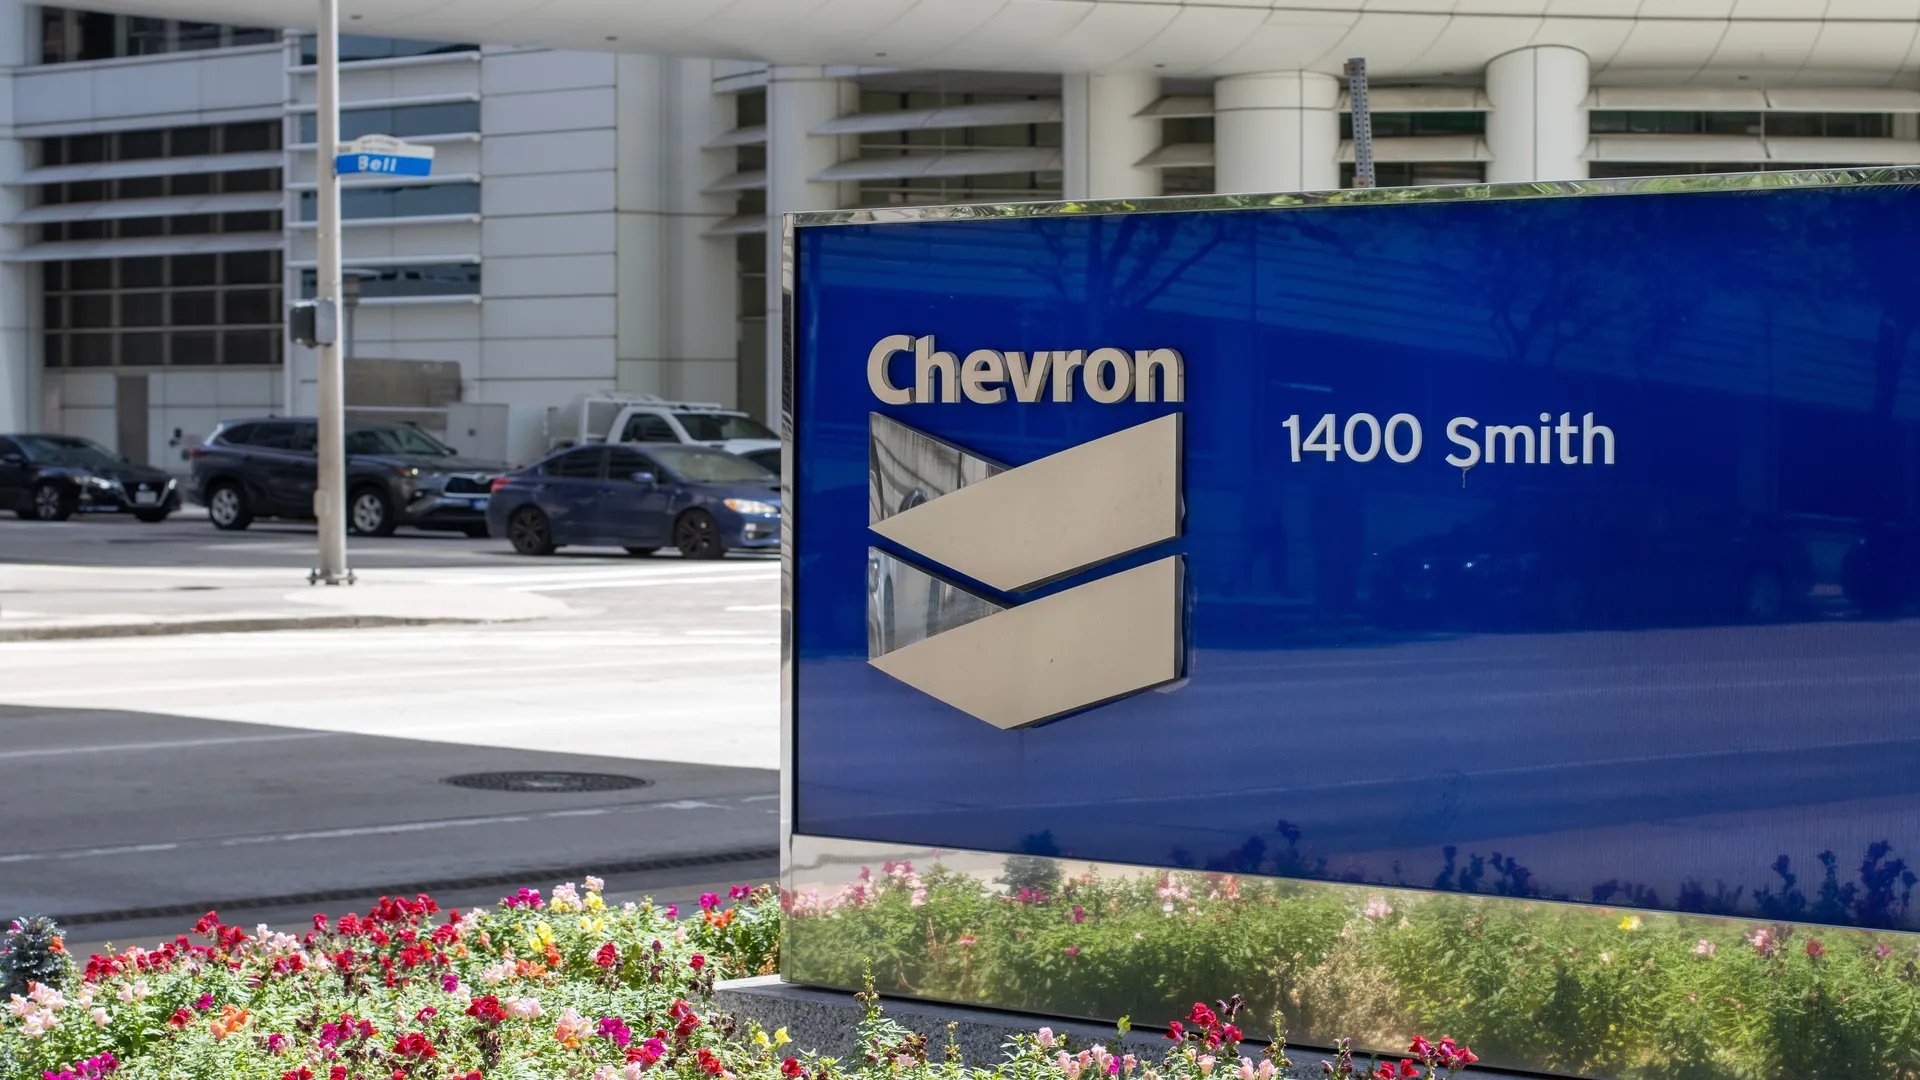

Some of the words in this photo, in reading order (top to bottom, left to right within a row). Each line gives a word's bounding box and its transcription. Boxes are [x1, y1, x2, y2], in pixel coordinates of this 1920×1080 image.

[358, 155, 397, 172] Bell
[867, 334, 1185, 405] Chevron
[1282, 412, 1423, 463] 1400
[1445, 412, 1615, 468] Smith
